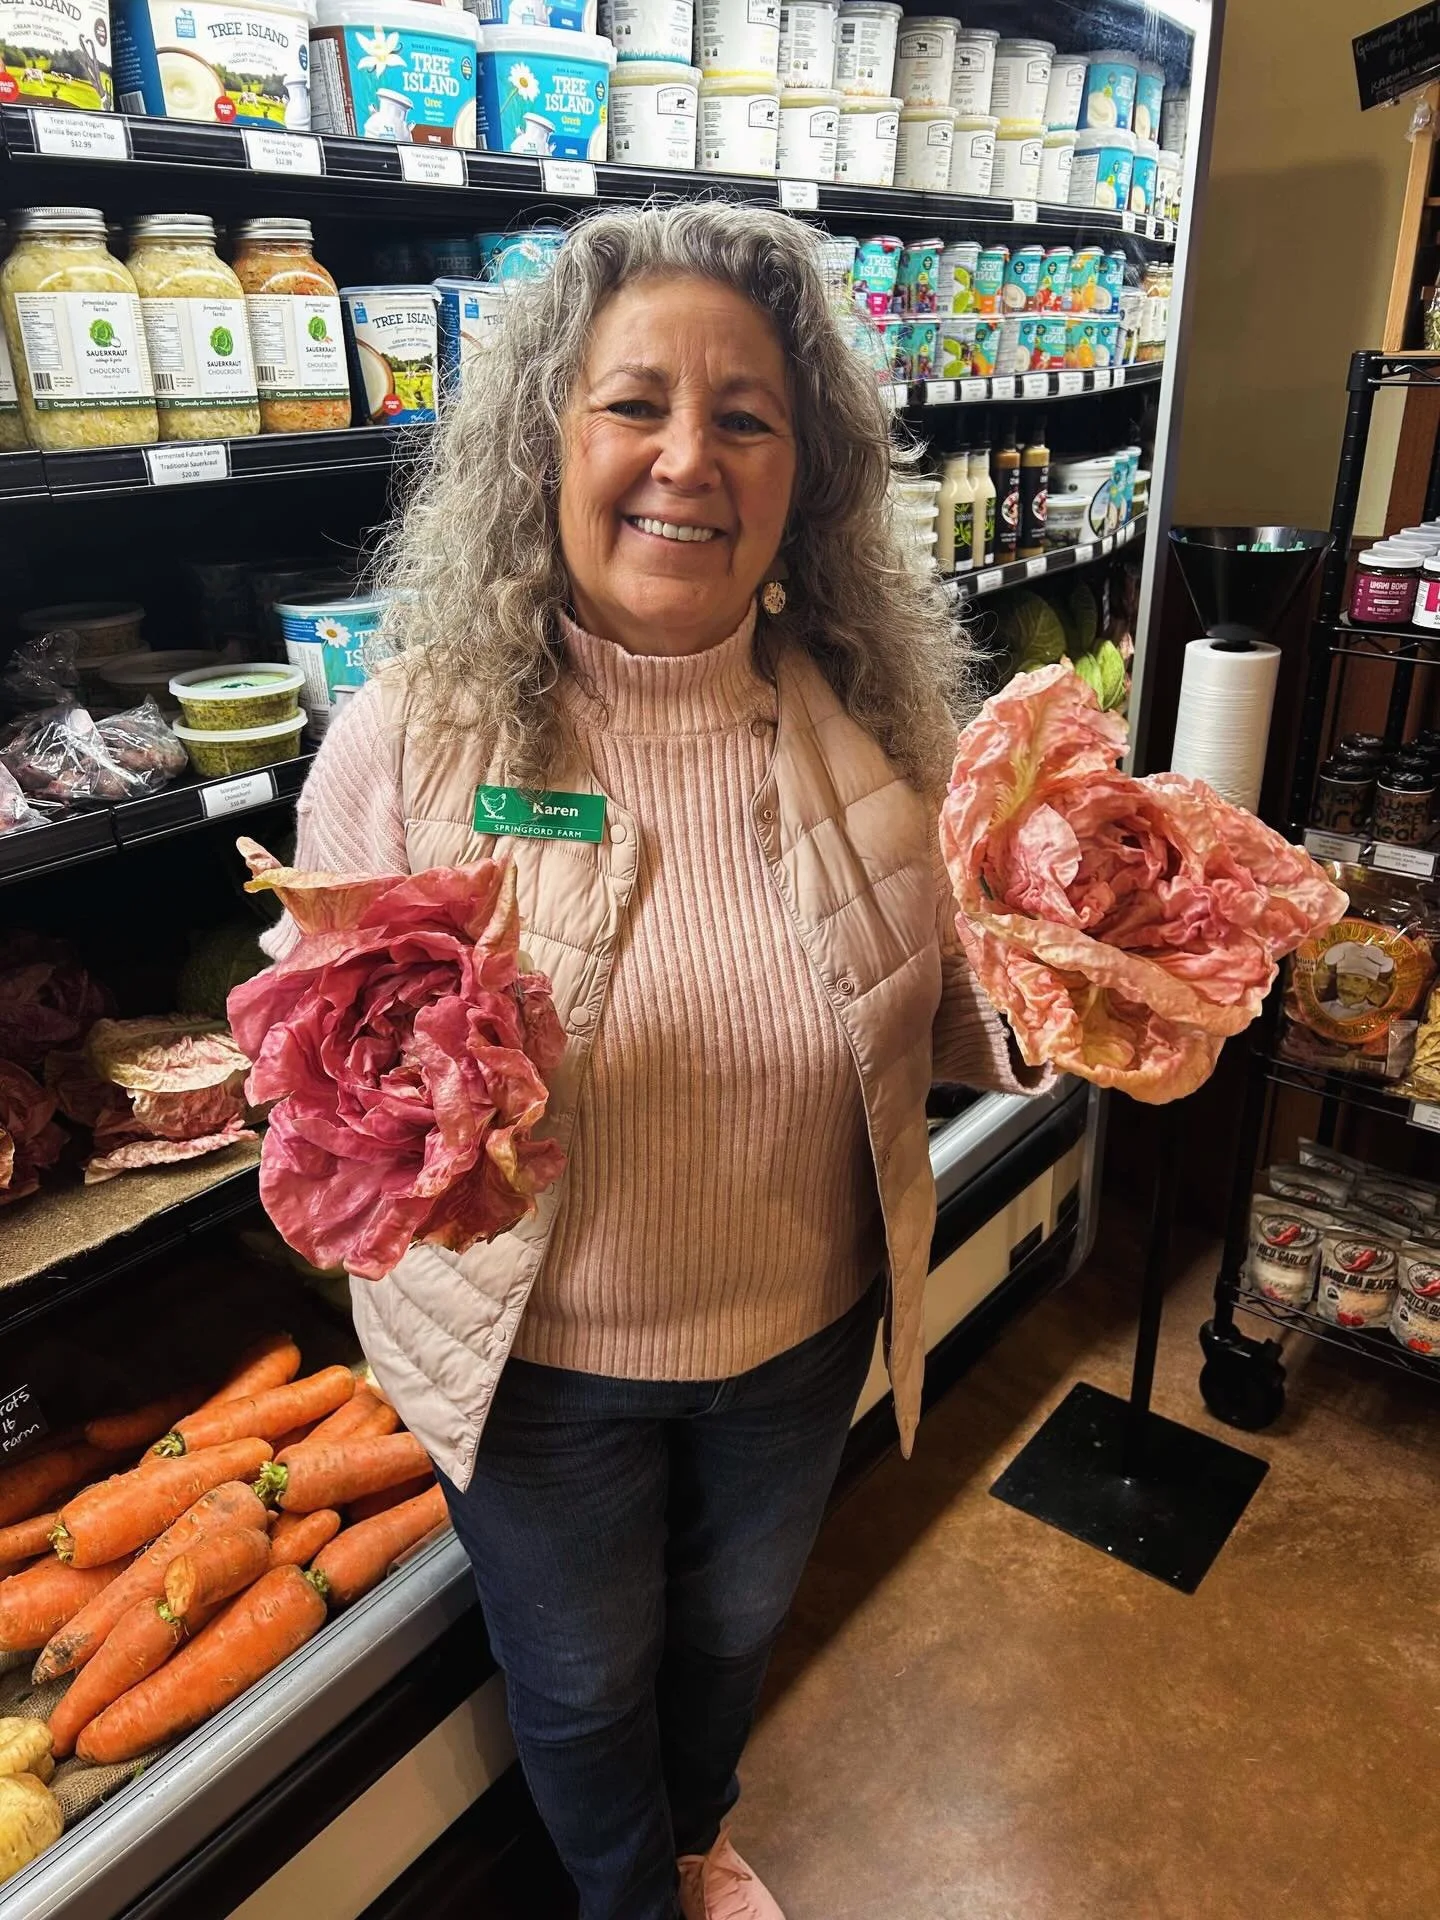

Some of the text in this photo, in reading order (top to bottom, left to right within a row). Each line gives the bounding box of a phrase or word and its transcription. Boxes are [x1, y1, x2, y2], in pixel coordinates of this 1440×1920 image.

[208, 21, 243, 38] TREE
[246, 22, 289, 48] ISLAND
[411, 52, 451, 76] TREE
[402, 72, 460, 97] ISLAND
[552, 75, 587, 97] TREE
[545, 93, 595, 115] ISLAND
[65, 118, 84, 126] Island
[84, 120, 105, 129] Yogurt
[43, 127, 115, 140] Vanilla Bean Cream Top
[436, 256, 472, 270] TREE
[373, 314, 404, 328] TREE
[207, 360, 242, 368] SAUERKRAUT
[208, 368, 243, 376] CHOUCROUTE
[154, 452, 185, 460] Fermented
[186, 451, 203, 459] Future
[160, 459, 217, 470] Traditional Sauerkraut
[182, 471, 200, 479] $20.00
[1370, 581, 1408, 590] UMAMI BOMB
[532, 802, 579, 817] Karen
[494, 824, 582, 838] SPRINGFORD FARM
[1321, 1266, 1364, 1288] CAROLINA
[2, 1423, 40, 1452] Farm
